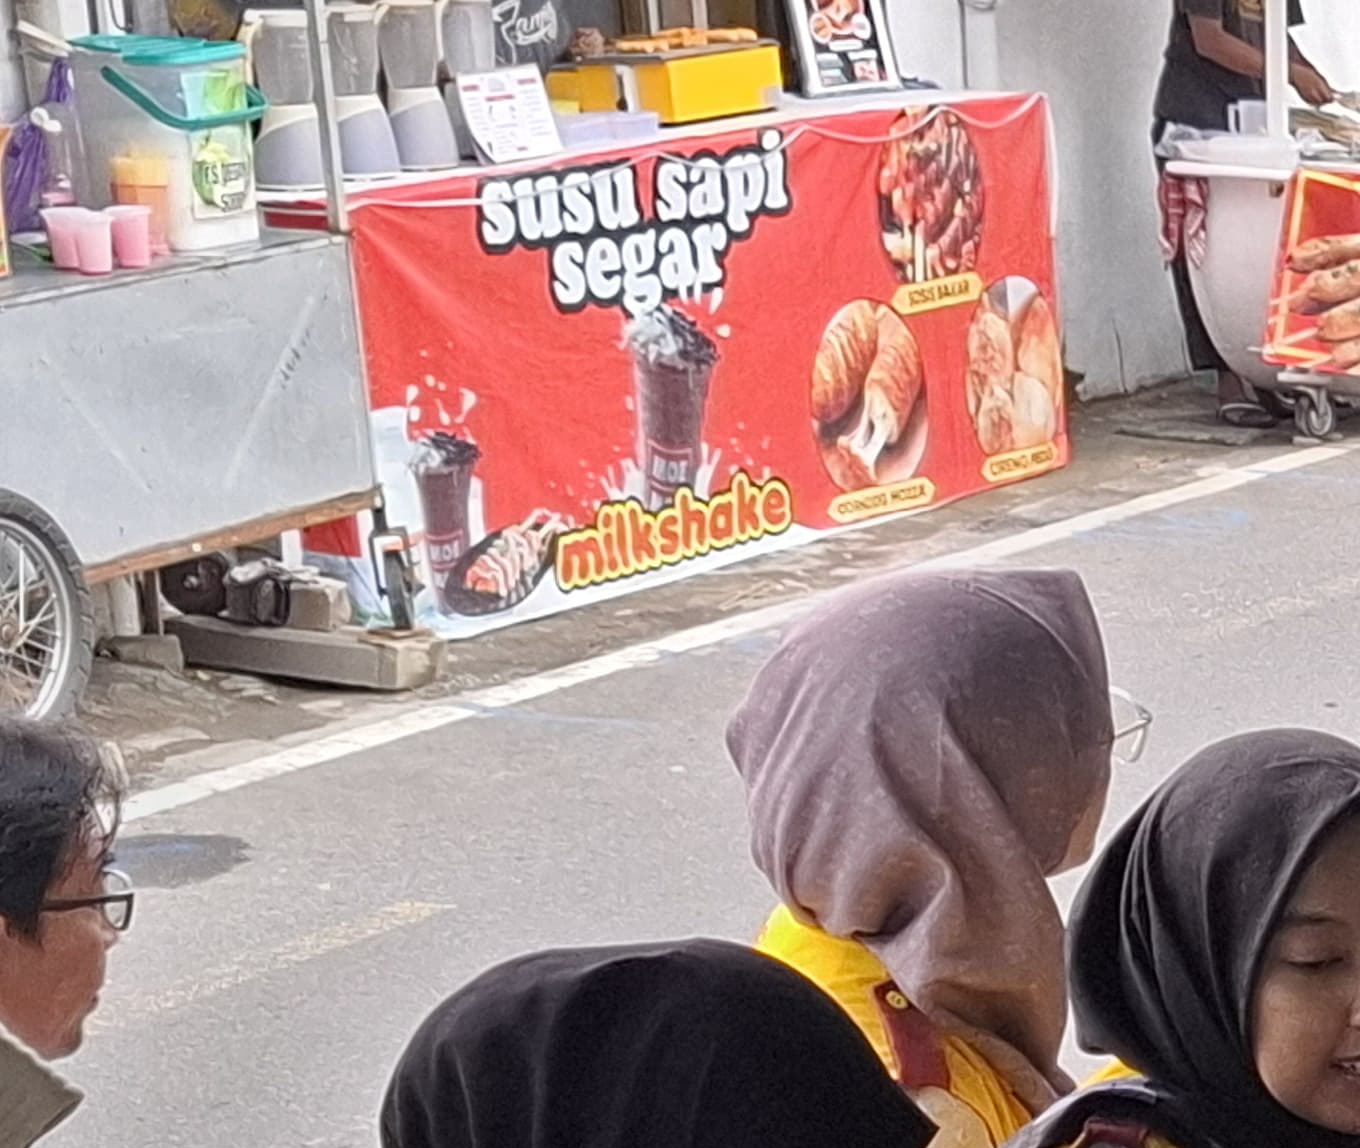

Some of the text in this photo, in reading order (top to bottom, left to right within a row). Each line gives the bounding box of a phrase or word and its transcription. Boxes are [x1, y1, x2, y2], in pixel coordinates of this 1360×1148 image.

[481, 128, 789, 245] susu sapi
[552, 221, 728, 315] segar
[557, 471, 792, 591] milkshake
